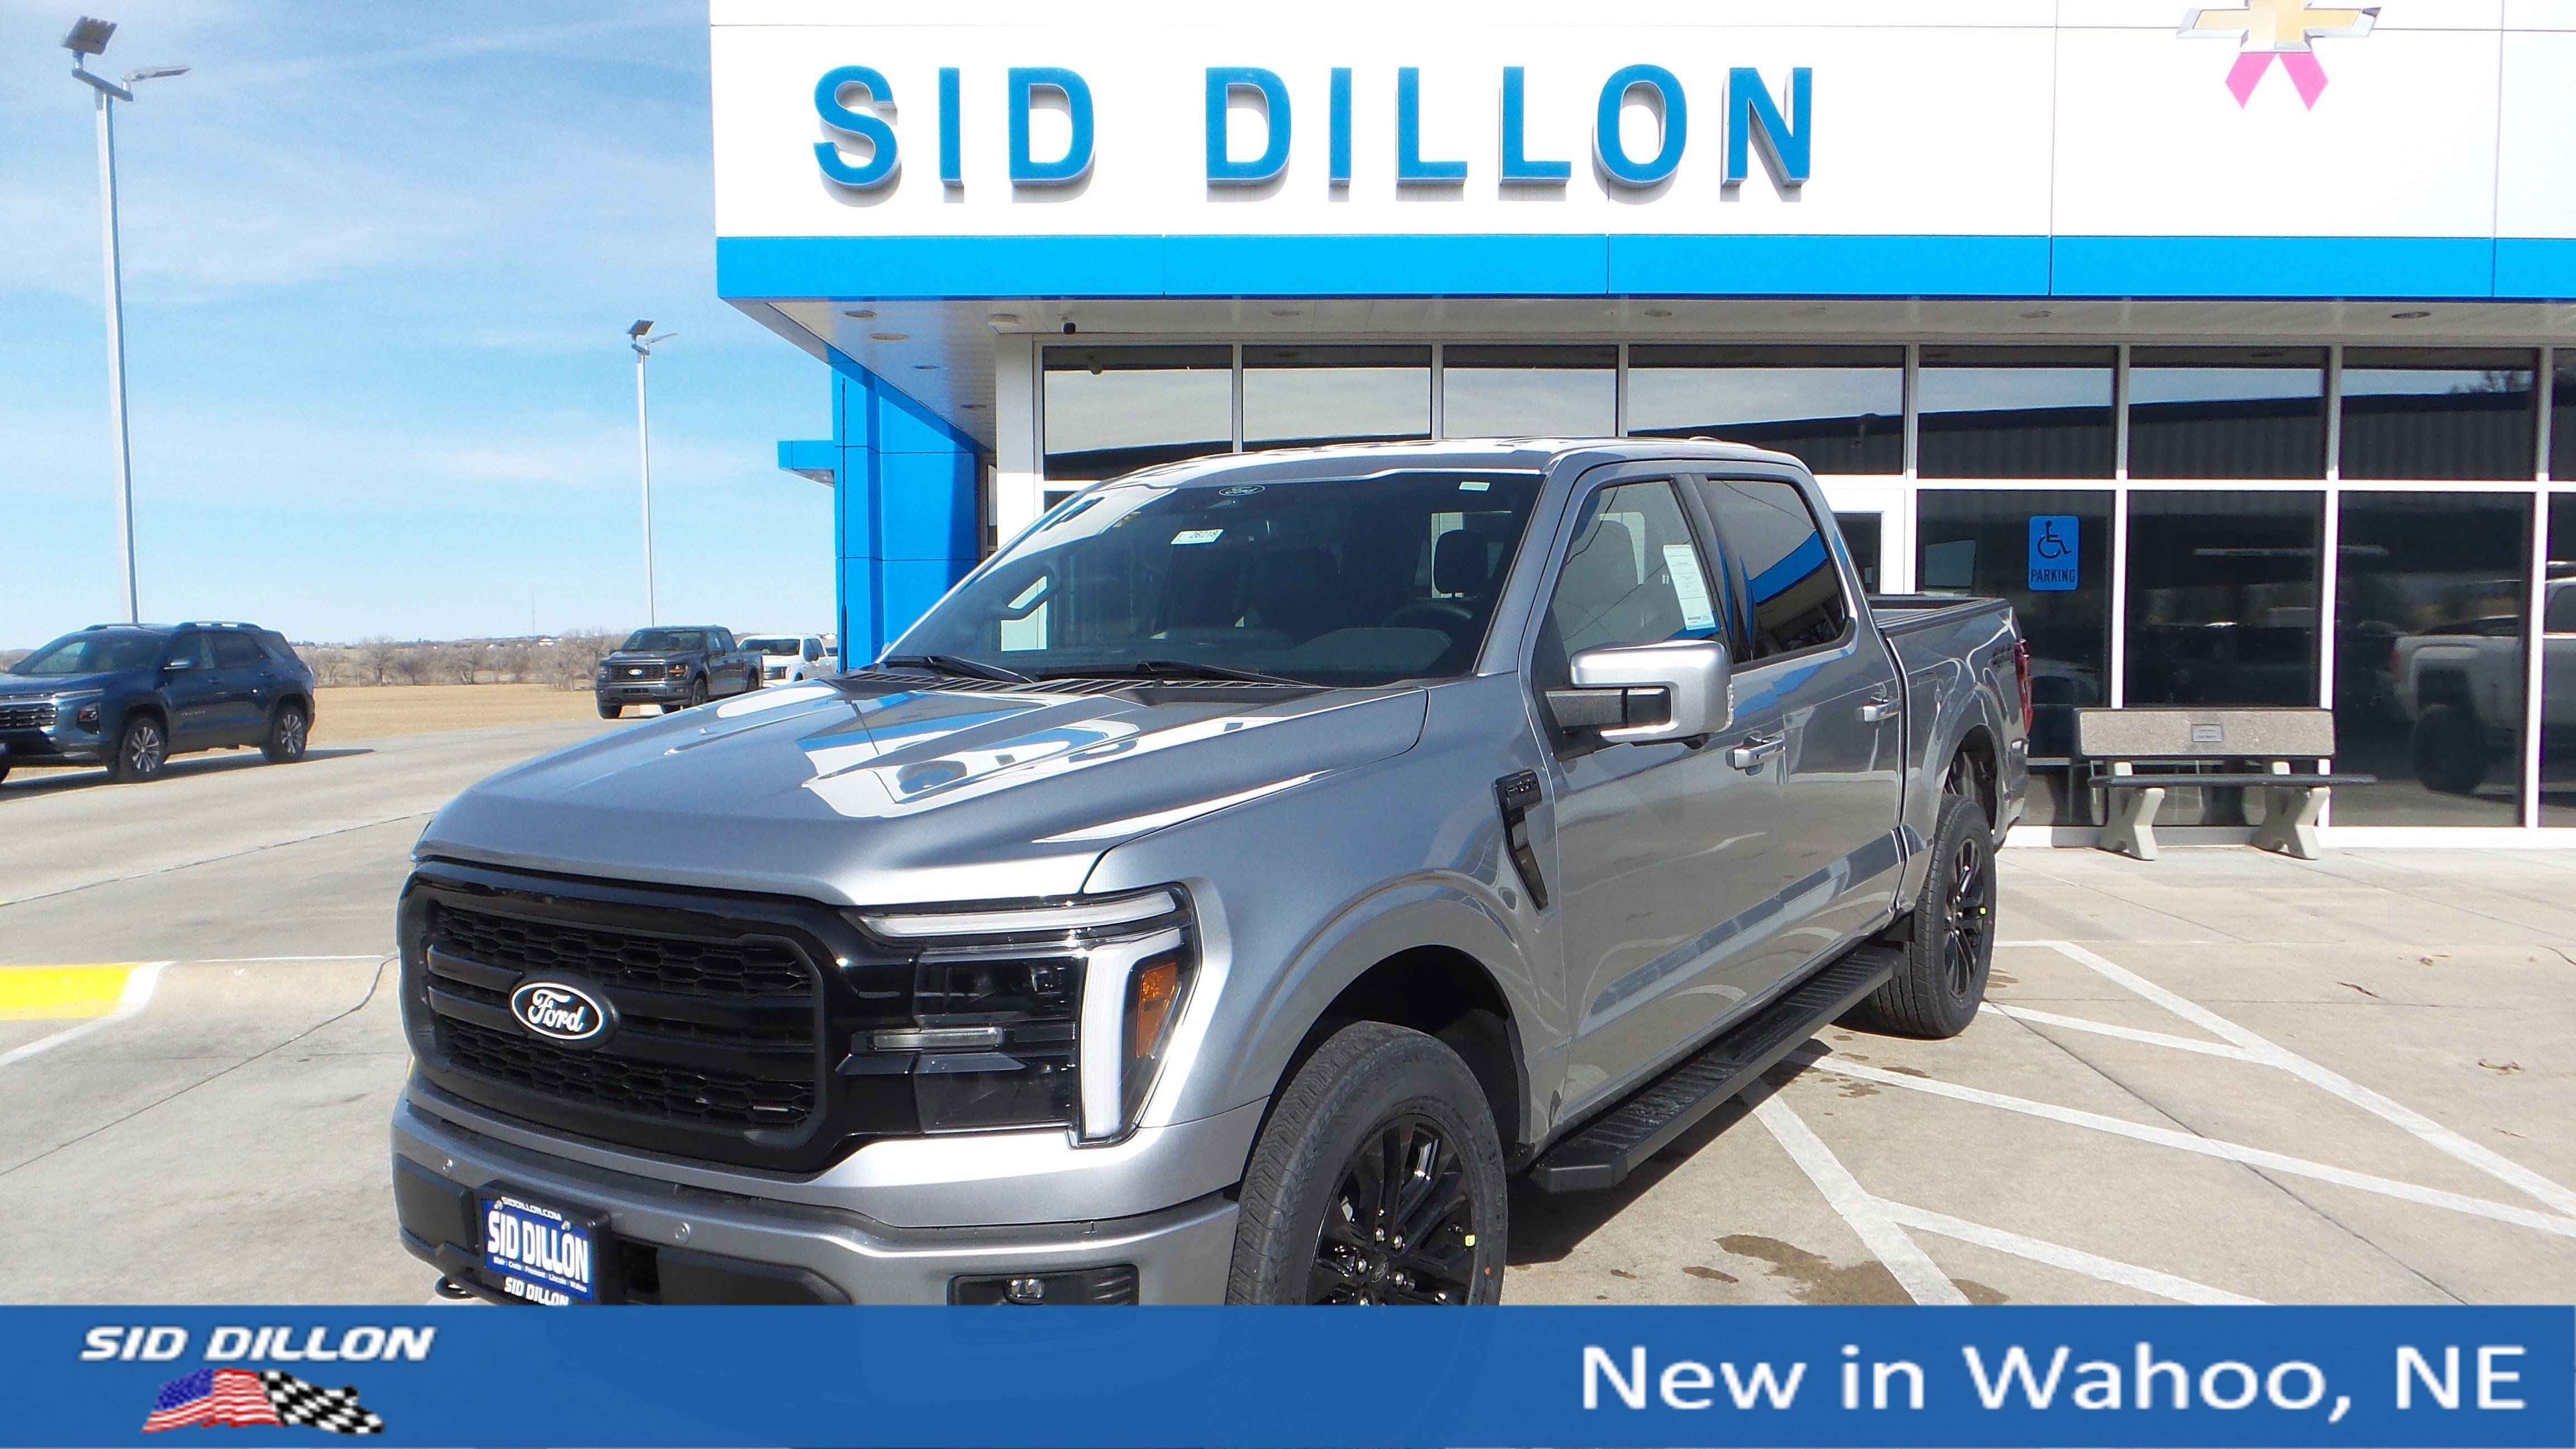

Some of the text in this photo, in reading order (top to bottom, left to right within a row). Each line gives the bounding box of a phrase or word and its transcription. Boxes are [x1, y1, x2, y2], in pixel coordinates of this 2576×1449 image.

[813, 63, 1812, 187] SID DILLON
[2030, 569, 2076, 583] PARKING
[527, 988, 586, 1033] Ford
[487, 1210, 589, 1284] SID DILLON
[504, 1276, 569, 1305] SID DILLON
